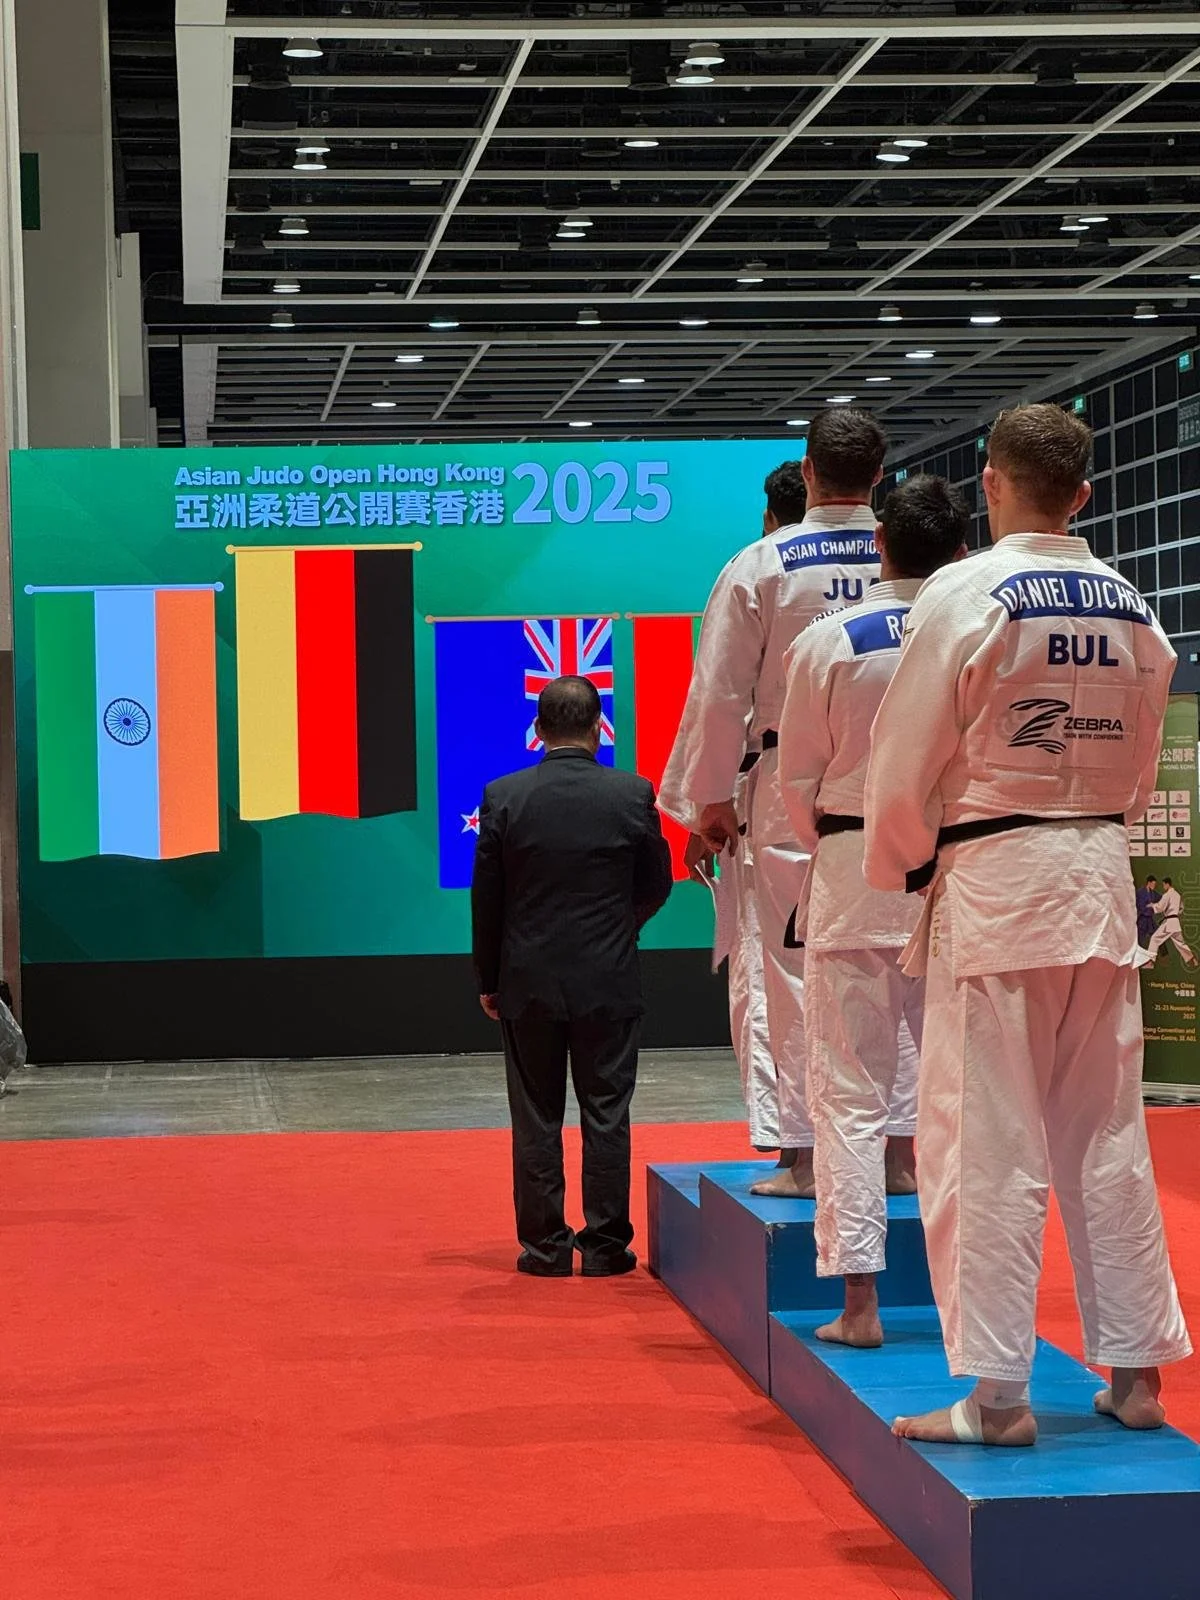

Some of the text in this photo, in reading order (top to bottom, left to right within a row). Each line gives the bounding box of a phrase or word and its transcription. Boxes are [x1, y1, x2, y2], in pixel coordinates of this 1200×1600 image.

[175, 463, 505, 487] Asian Judo Open Hong Kong
[511, 461, 671, 523] 2025
[175, 490, 505, 528] 亞洲柔道公開賽香港
[782, 539, 881, 563] ASIAN CHAMPIO
[999, 578, 1074, 613] DANIEL
[1047, 633, 1119, 667] BUL
[1063, 716, 1124, 732] ZEBRA
